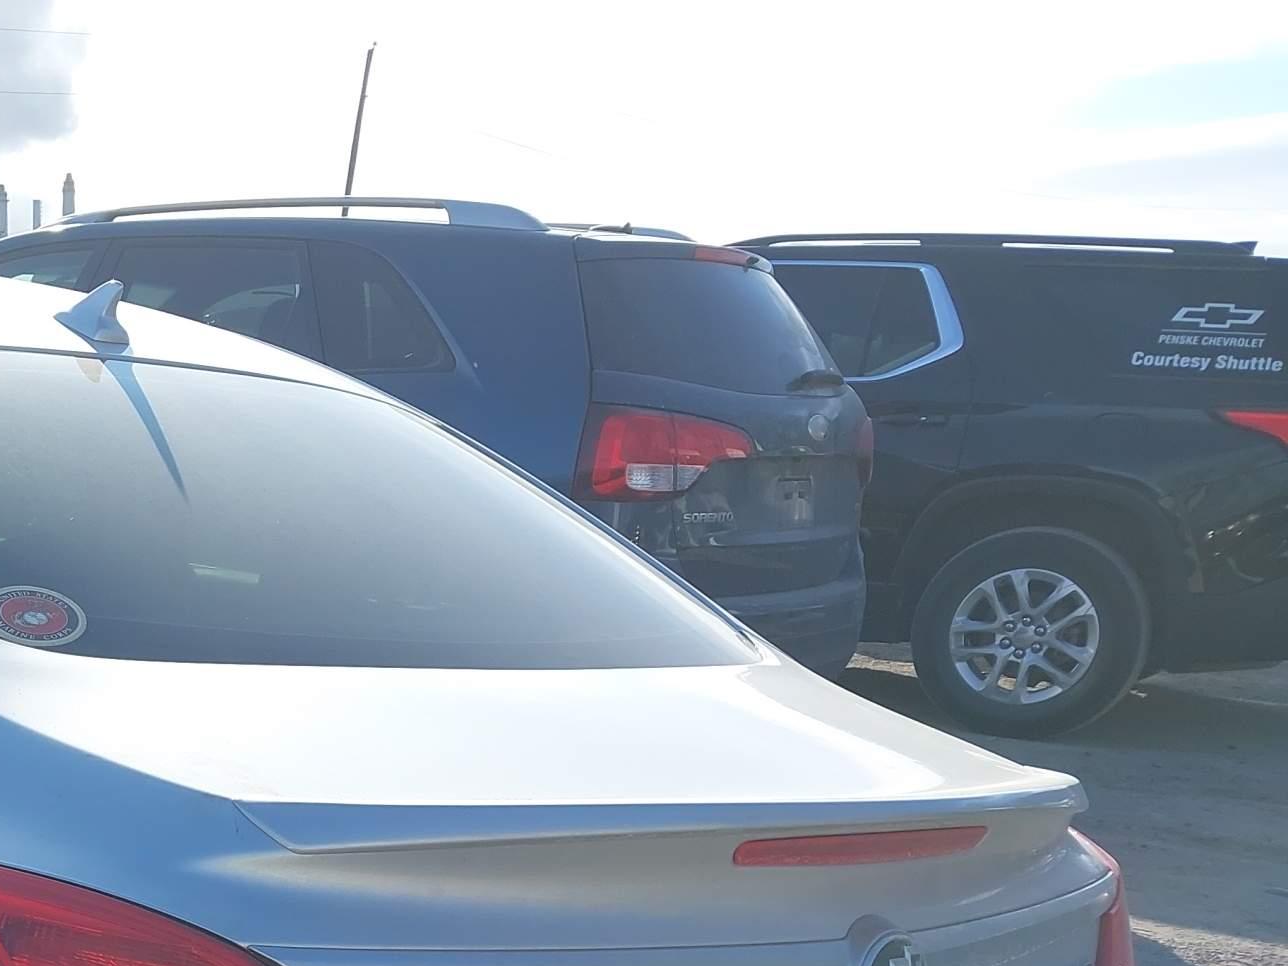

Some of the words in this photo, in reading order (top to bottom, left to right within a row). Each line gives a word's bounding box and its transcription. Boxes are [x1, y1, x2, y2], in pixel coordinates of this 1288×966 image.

[1158, 334, 1199, 345] PENSKE
[1201, 336, 1265, 348] CHEVROLET
[1131, 351, 1211, 371] Courtesy
[1215, 355, 1284, 372] Shuttle
[682, 511, 734, 524] SORENTO
[36, 592, 69, 609] STATES
[43, 627, 73, 640] CORPS
